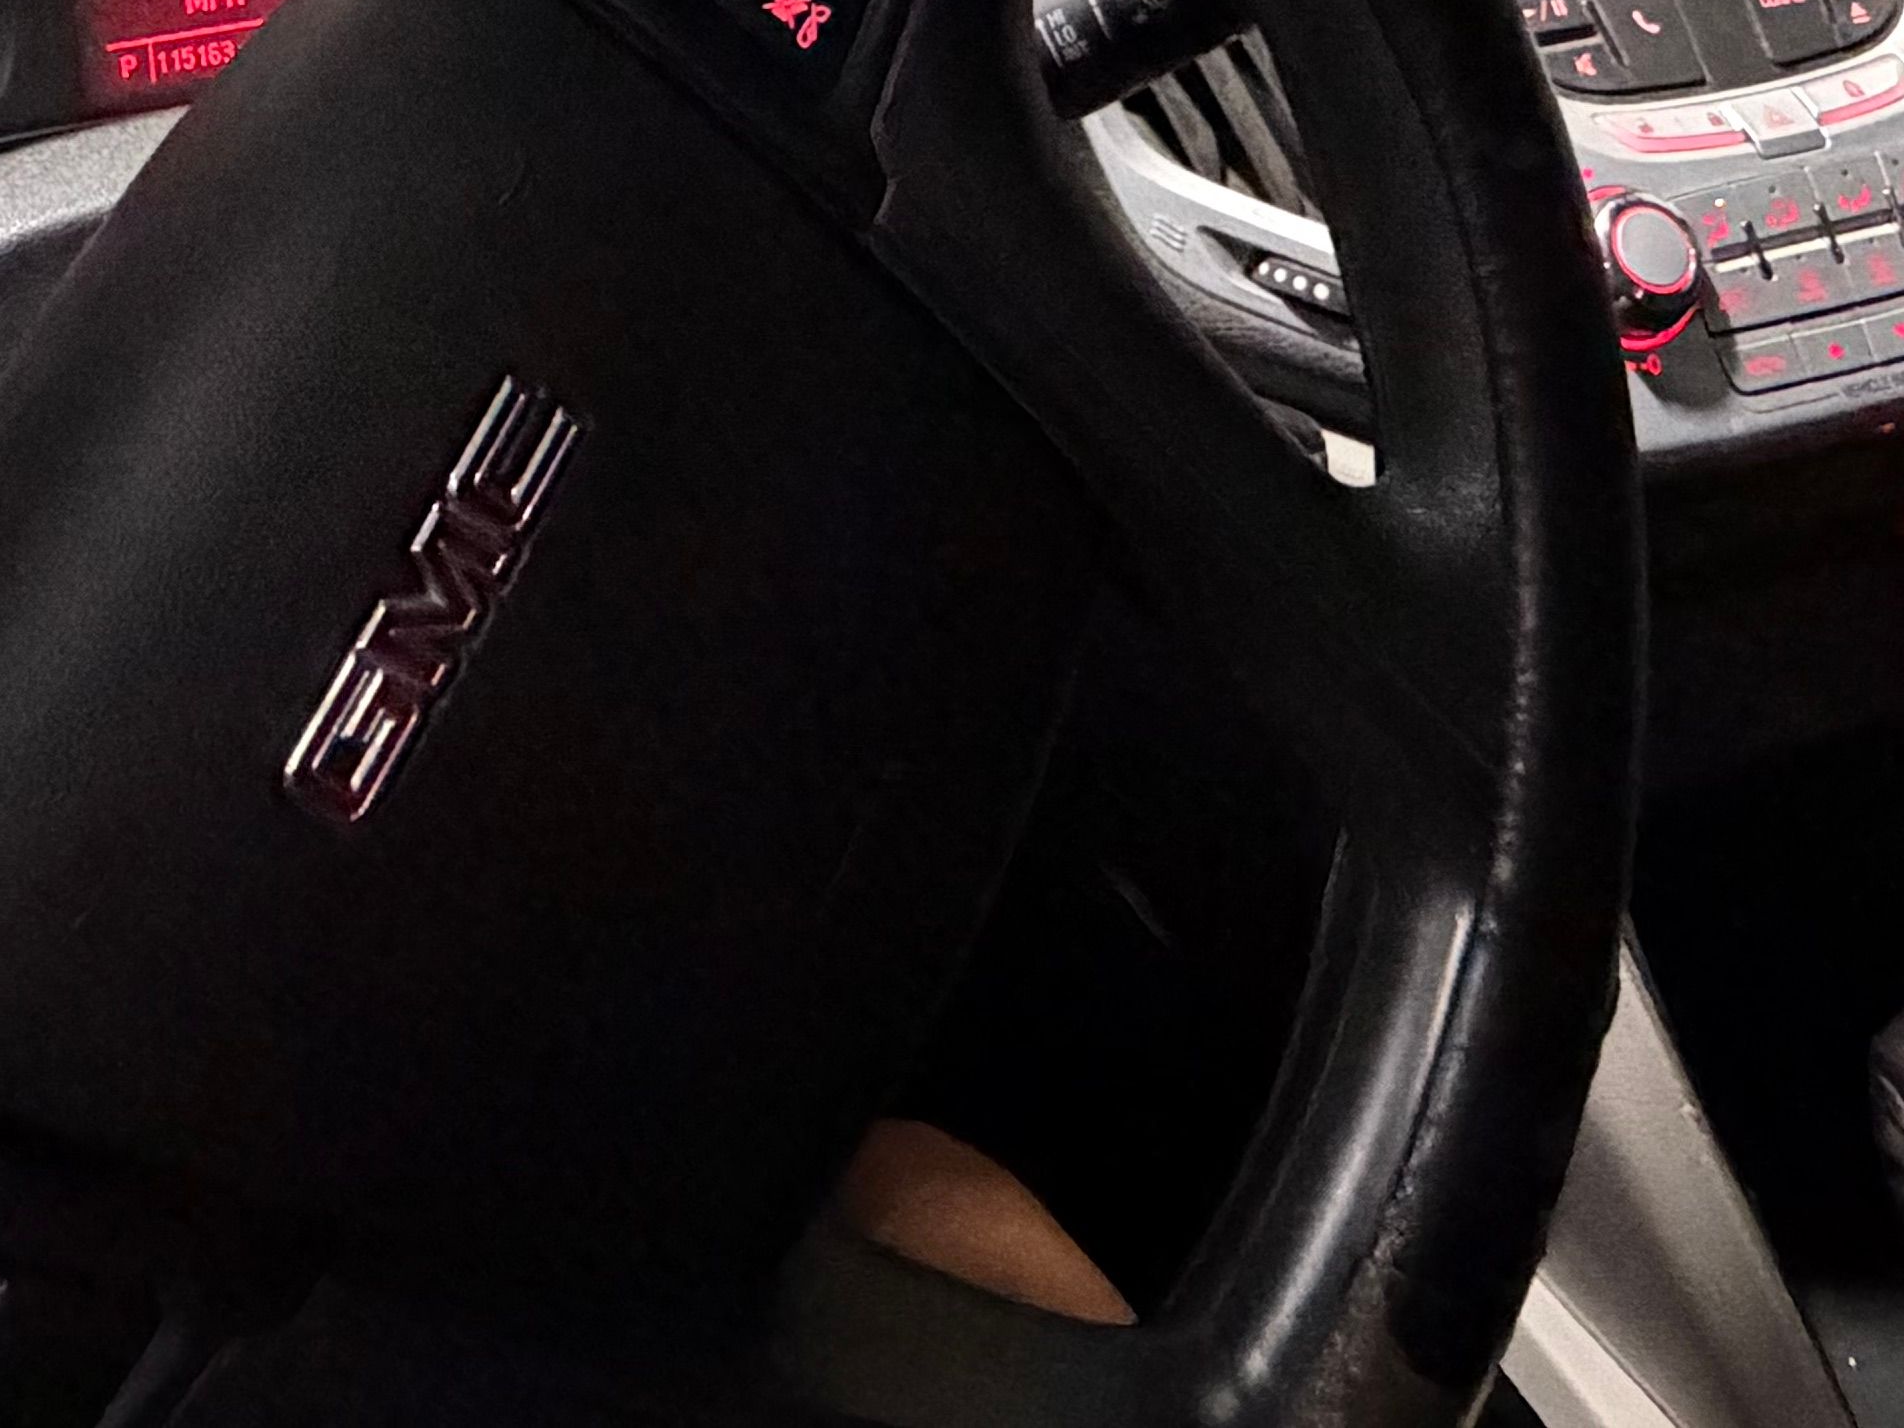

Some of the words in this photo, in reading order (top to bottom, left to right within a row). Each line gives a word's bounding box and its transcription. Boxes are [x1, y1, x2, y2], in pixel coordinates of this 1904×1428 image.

[1053, 25, 1078, 47] LO
[118, 53, 139, 80] P
[157, 40, 238, 75] 115163
[282, 373, 582, 824] GMC
